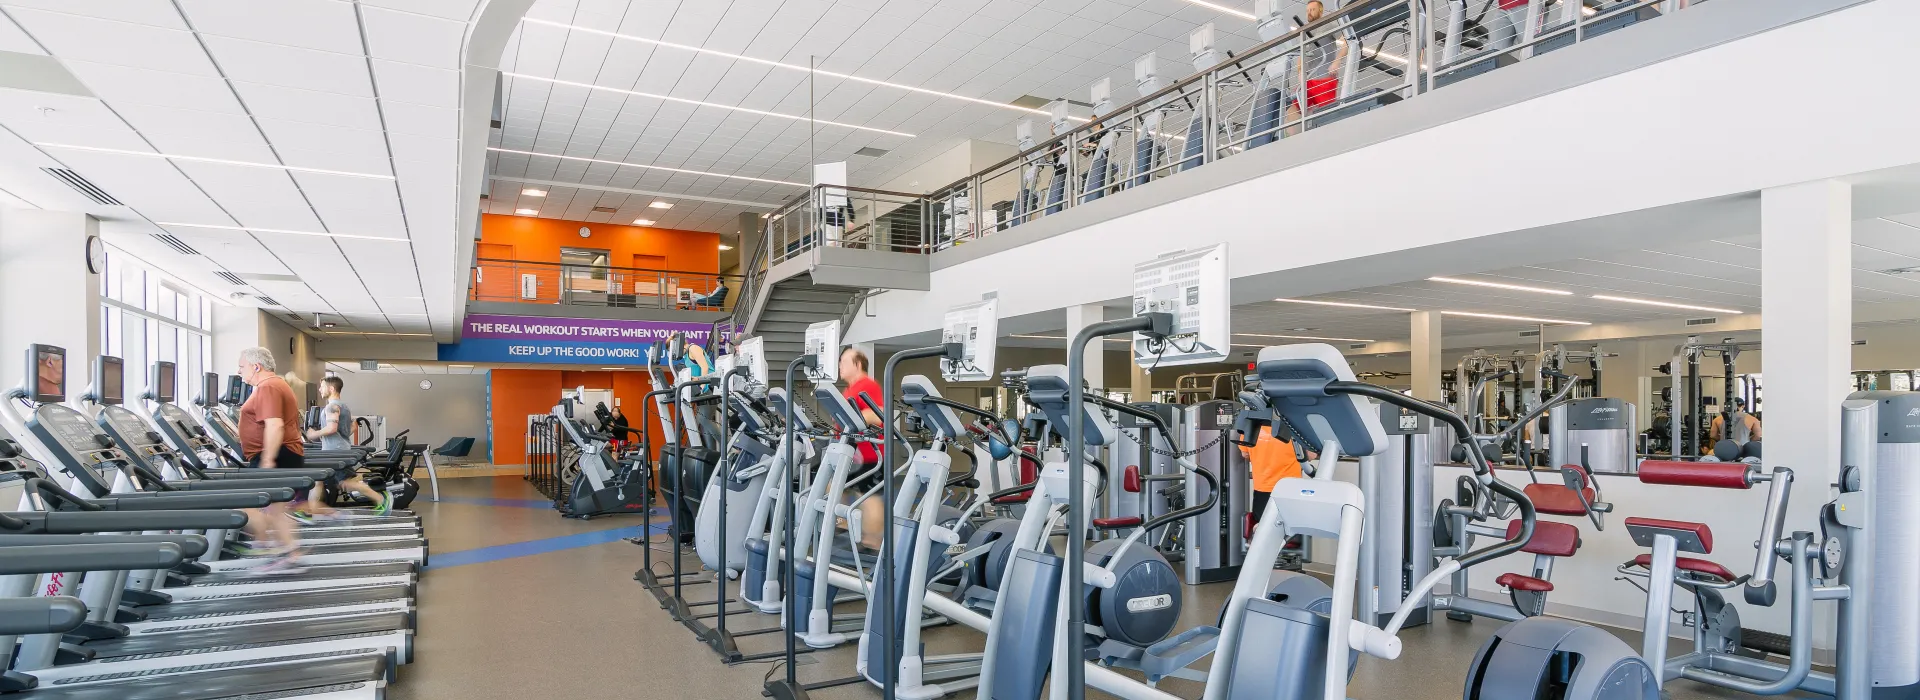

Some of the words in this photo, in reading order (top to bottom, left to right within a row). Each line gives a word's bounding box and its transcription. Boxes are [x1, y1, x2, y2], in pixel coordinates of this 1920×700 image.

[470, 322, 493, 333] THE
[495, 323, 522, 334] REAL
[524, 324, 580, 336] WORKOUT
[581, 326, 620, 337] STARTS
[621, 327, 651, 338] WHEN
[652, 329, 673, 339] YOU
[509, 345, 536, 356] KEEP
[537, 346, 552, 356] UP
[553, 346, 574, 357] THE
[575, 347, 605, 357] GOOD
[606, 348, 639, 358] WORK!
